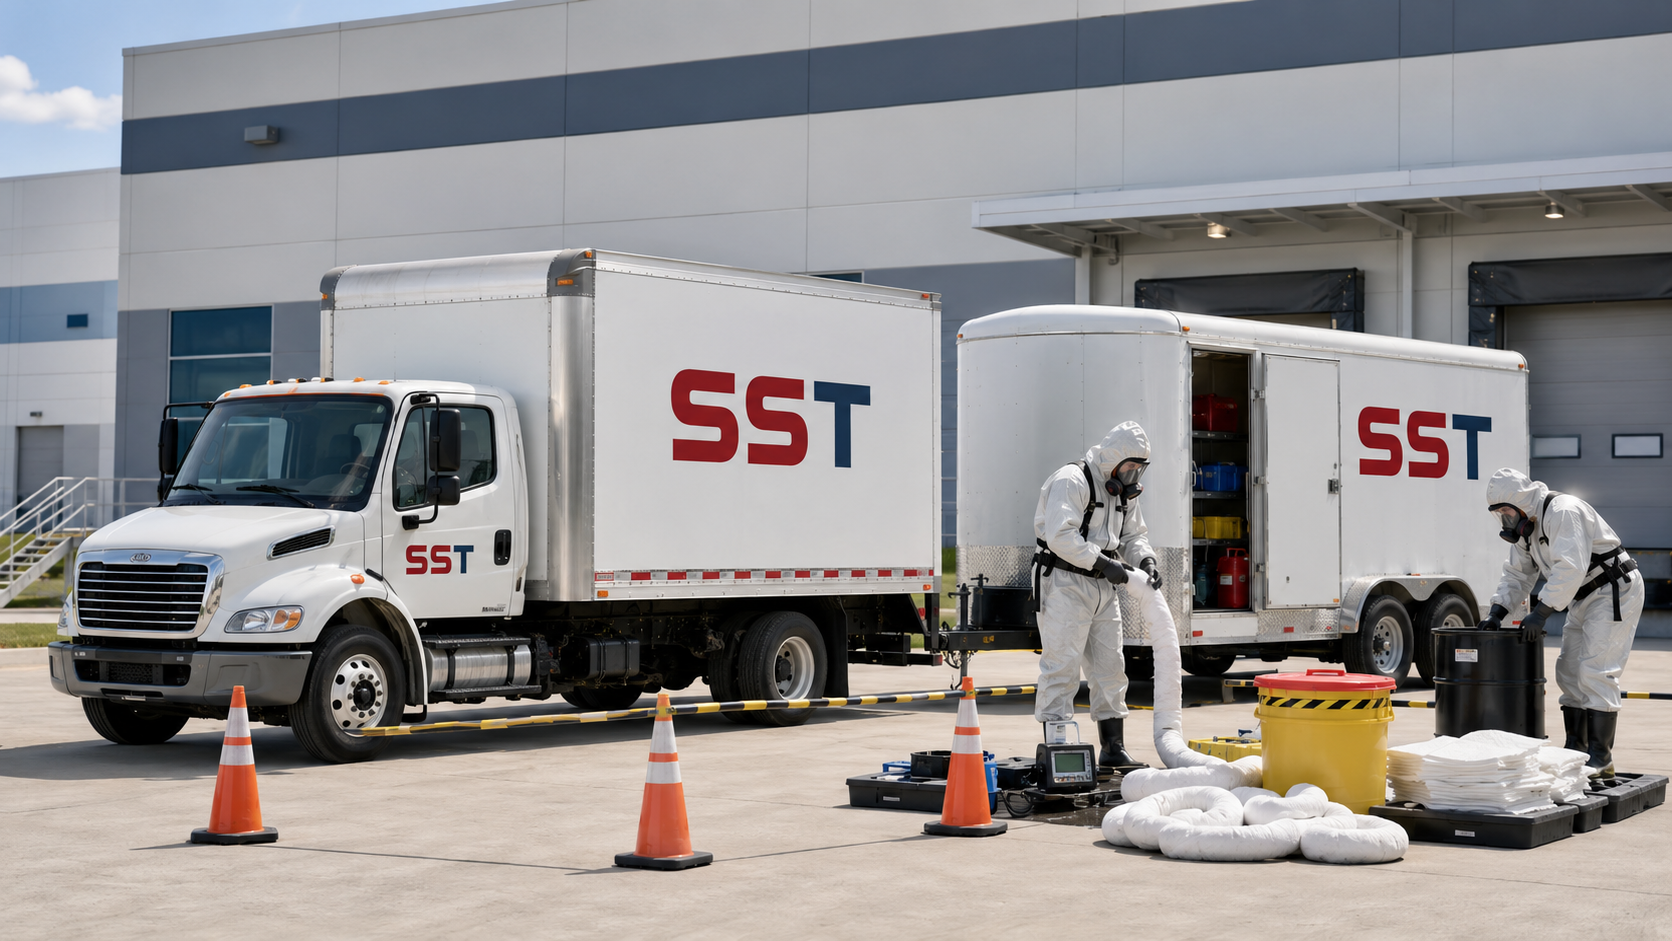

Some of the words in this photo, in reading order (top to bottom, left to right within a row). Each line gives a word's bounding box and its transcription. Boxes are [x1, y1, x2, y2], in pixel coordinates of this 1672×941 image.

[671, 368, 871, 468] SST
[1358, 406, 1492, 480] SST
[405, 544, 475, 575] SST
